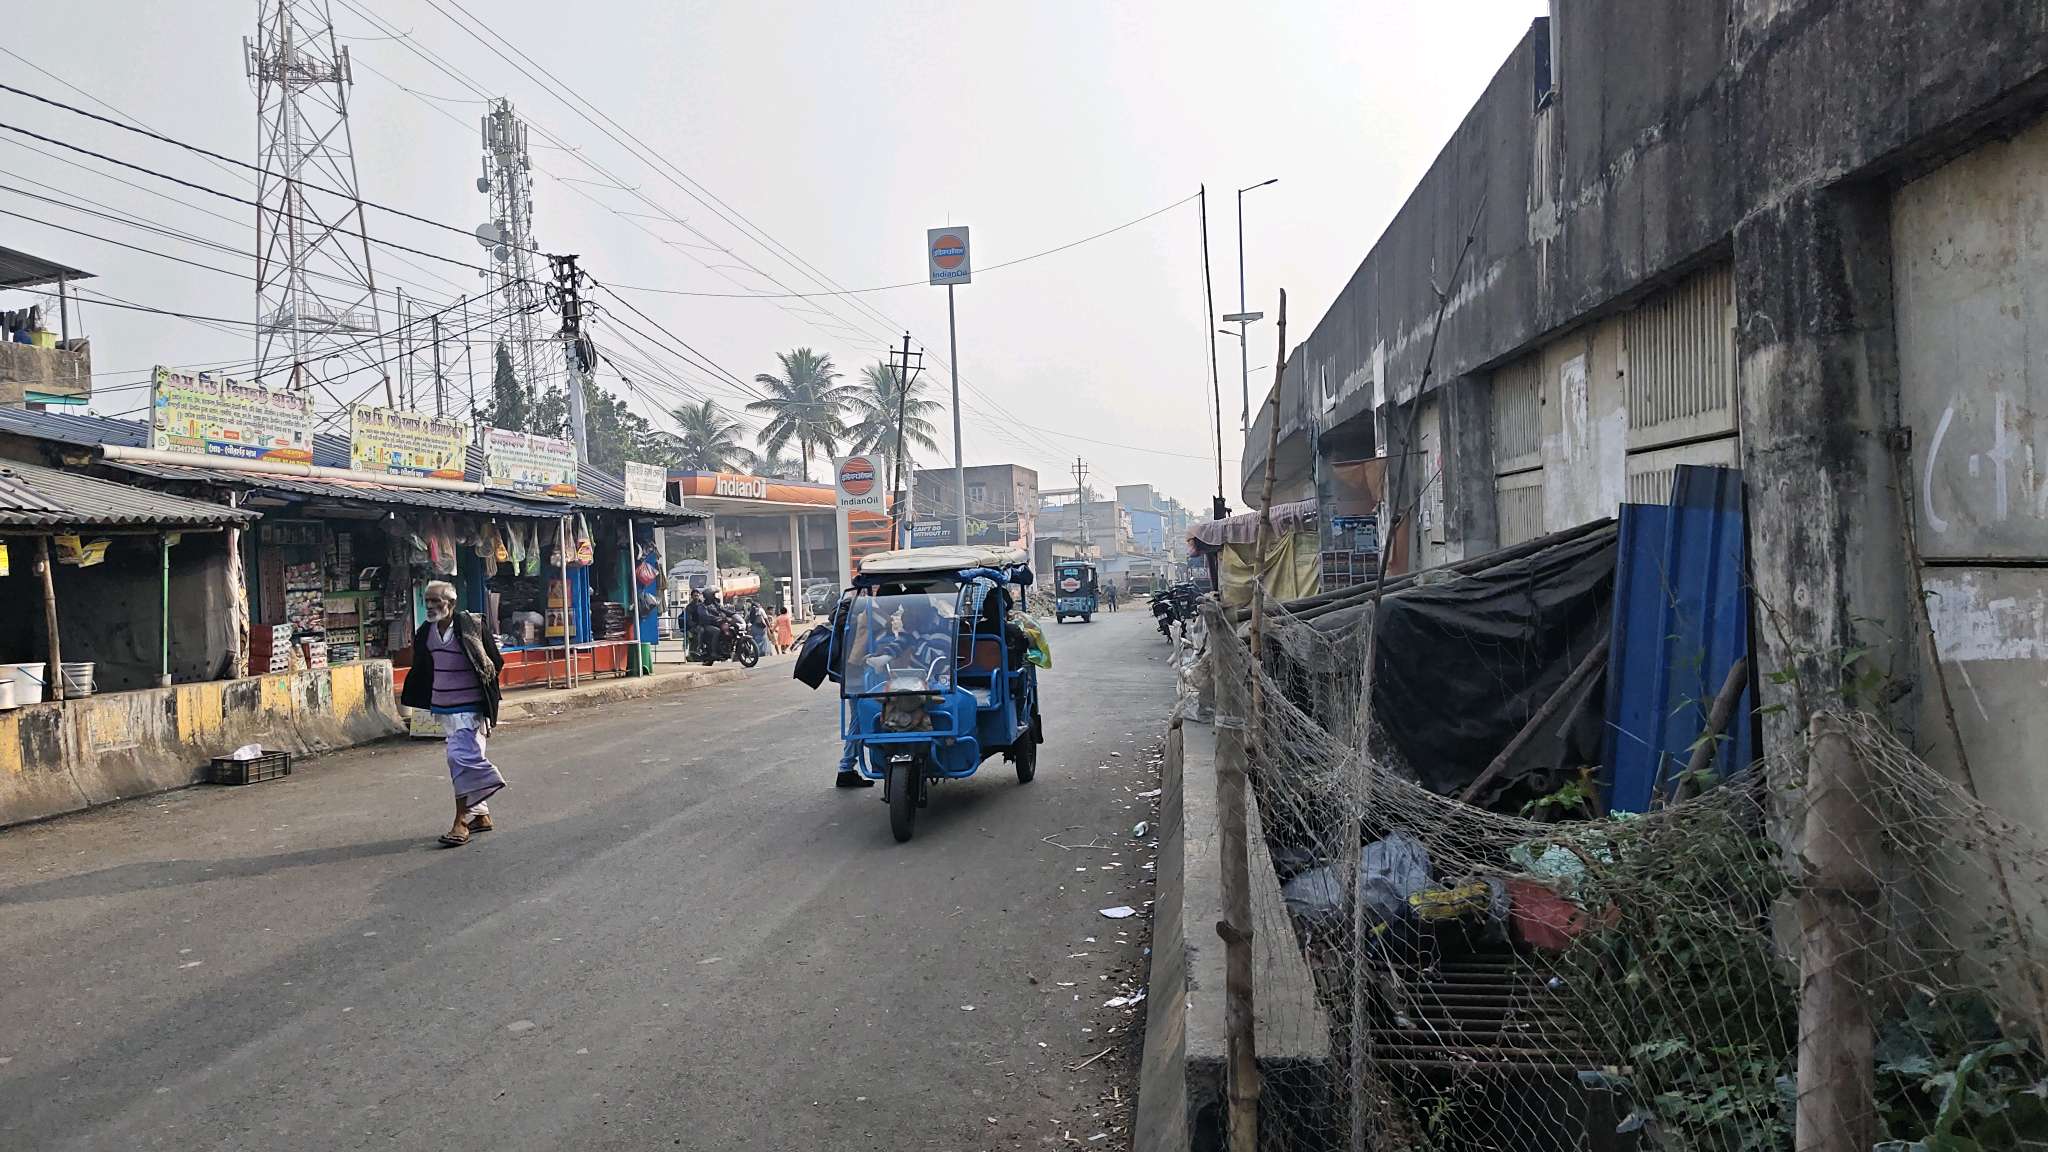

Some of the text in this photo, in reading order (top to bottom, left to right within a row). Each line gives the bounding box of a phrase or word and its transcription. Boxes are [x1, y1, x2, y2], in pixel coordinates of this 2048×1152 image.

[932, 270, 968, 279] IndianOil
[716, 475, 767, 498] IndianOil
[841, 496, 879, 506] IndianOil
